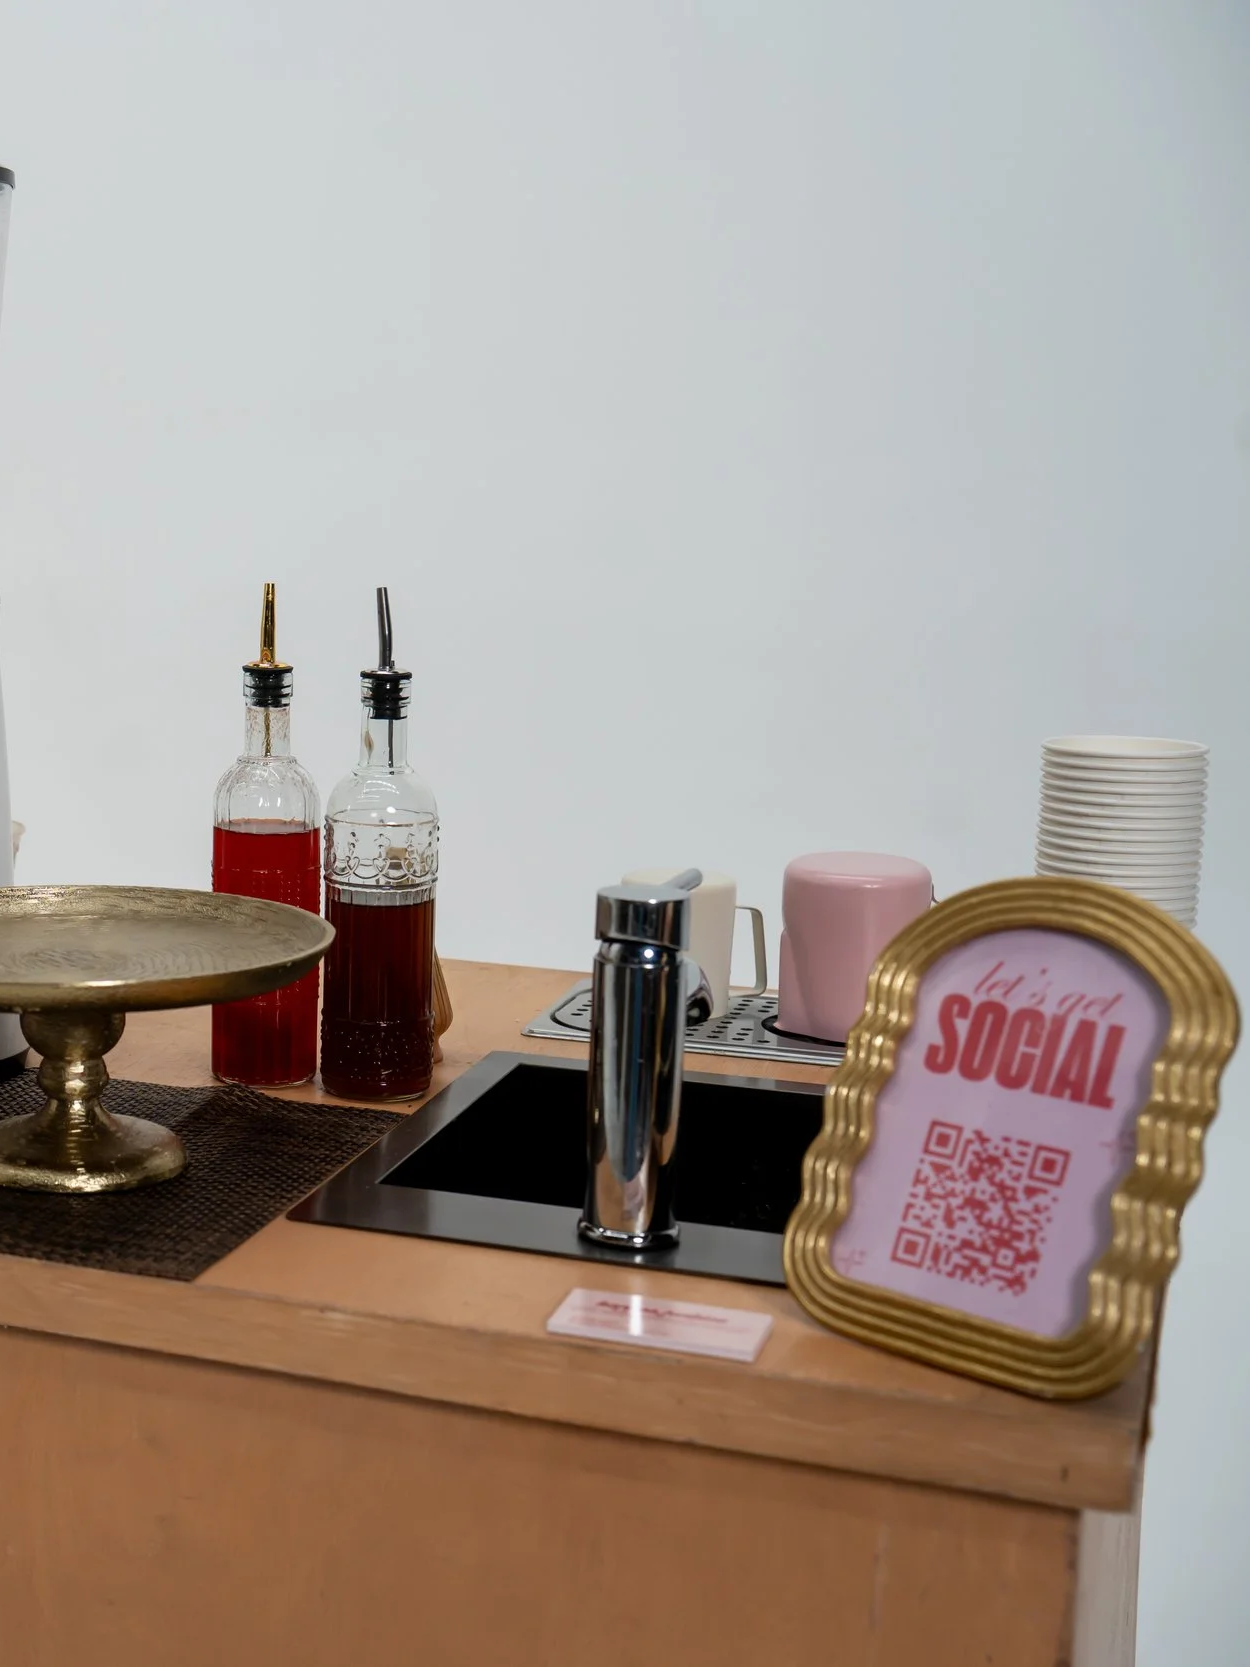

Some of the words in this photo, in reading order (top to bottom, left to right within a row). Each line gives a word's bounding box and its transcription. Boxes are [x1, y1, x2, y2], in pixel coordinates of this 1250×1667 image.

[973, 960, 1052, 1007] let's
[1057, 993, 1124, 1019] get
[923, 993, 1127, 1111] SOCIAL
